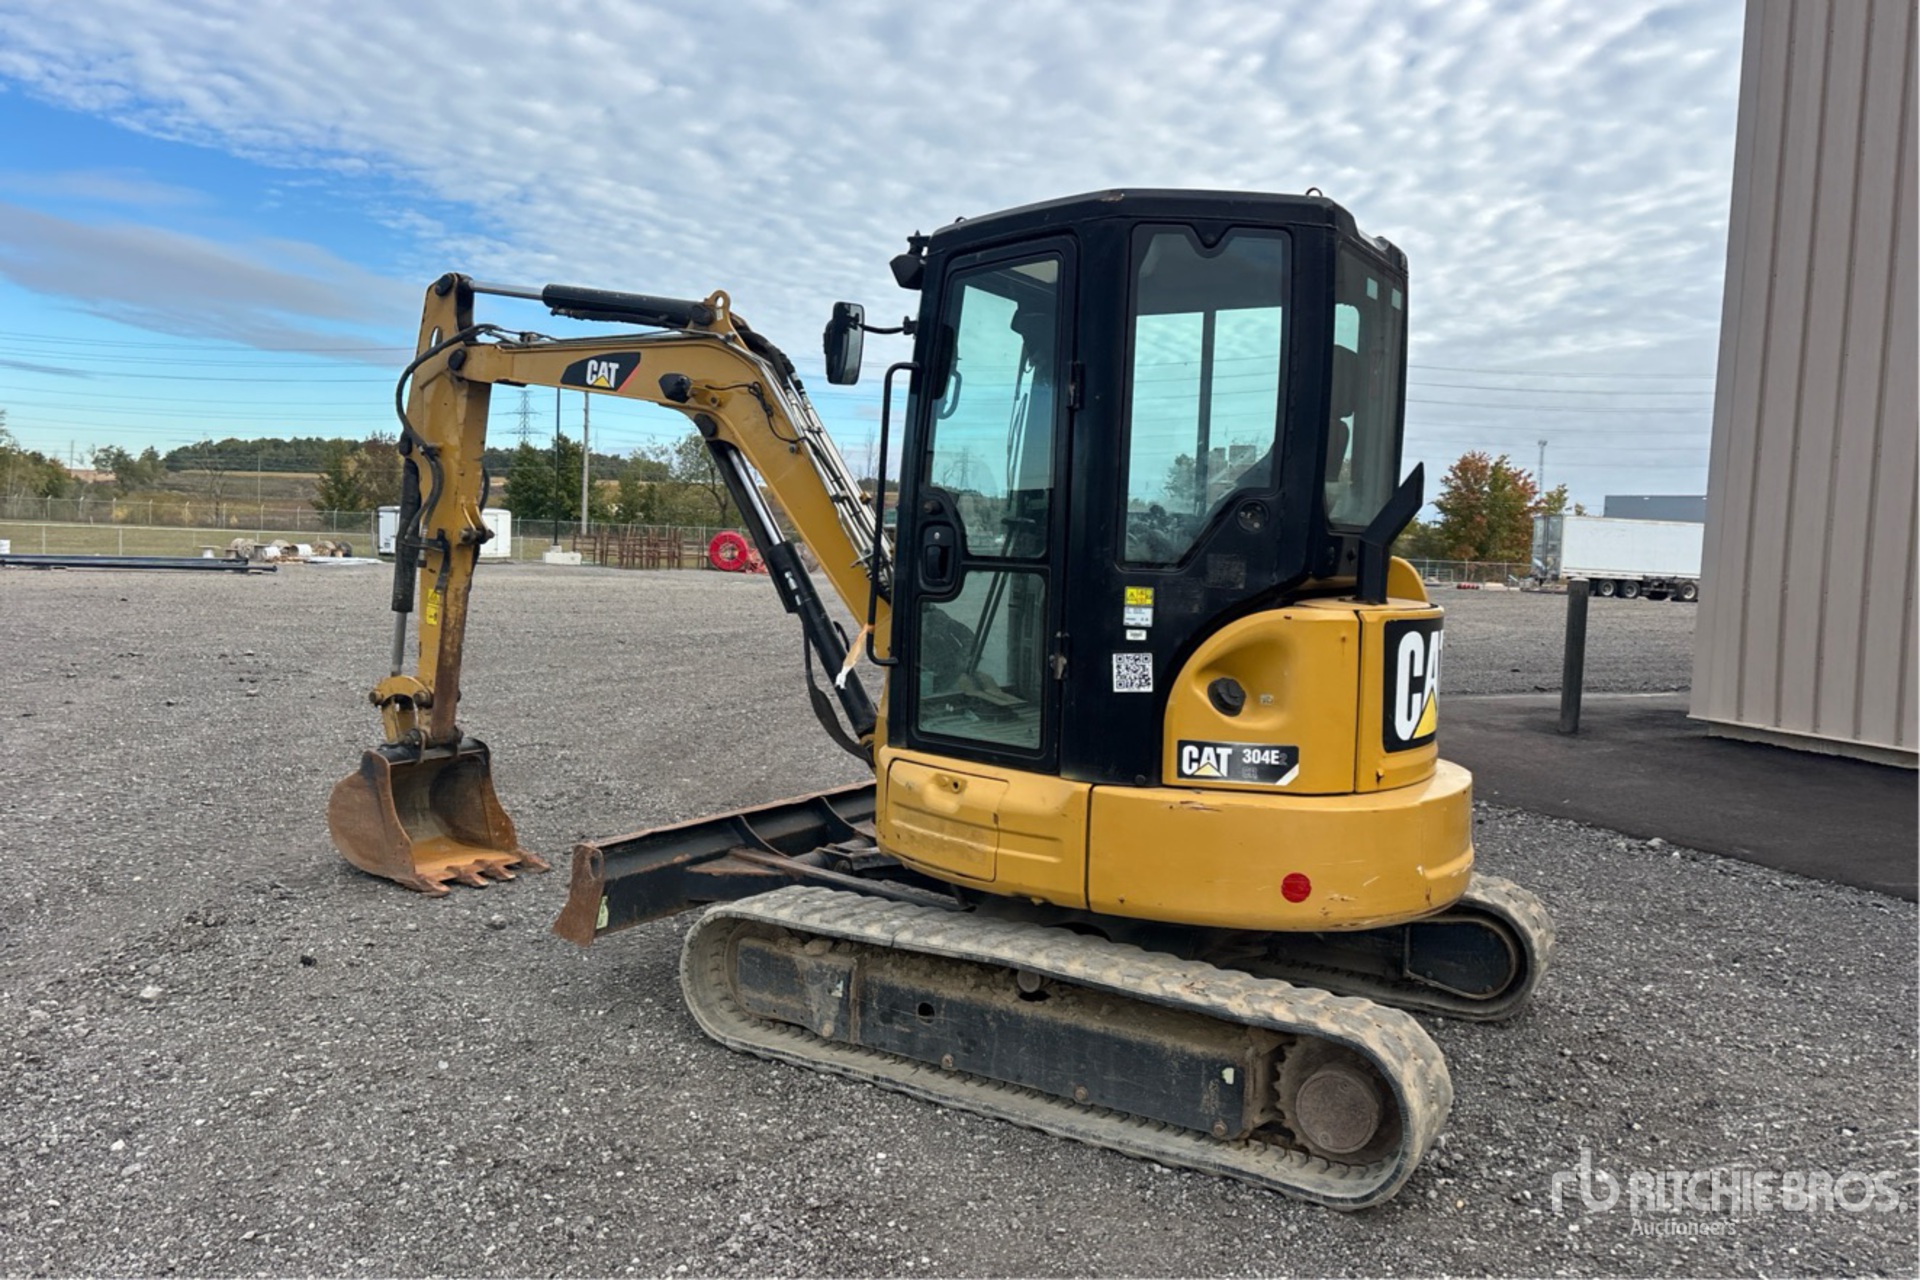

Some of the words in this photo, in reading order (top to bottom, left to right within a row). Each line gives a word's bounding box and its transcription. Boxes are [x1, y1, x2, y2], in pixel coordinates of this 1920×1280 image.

[586, 359, 619, 388] CAT
[1394, 630, 1444, 741] CA
[1182, 745, 1233, 777] CAT
